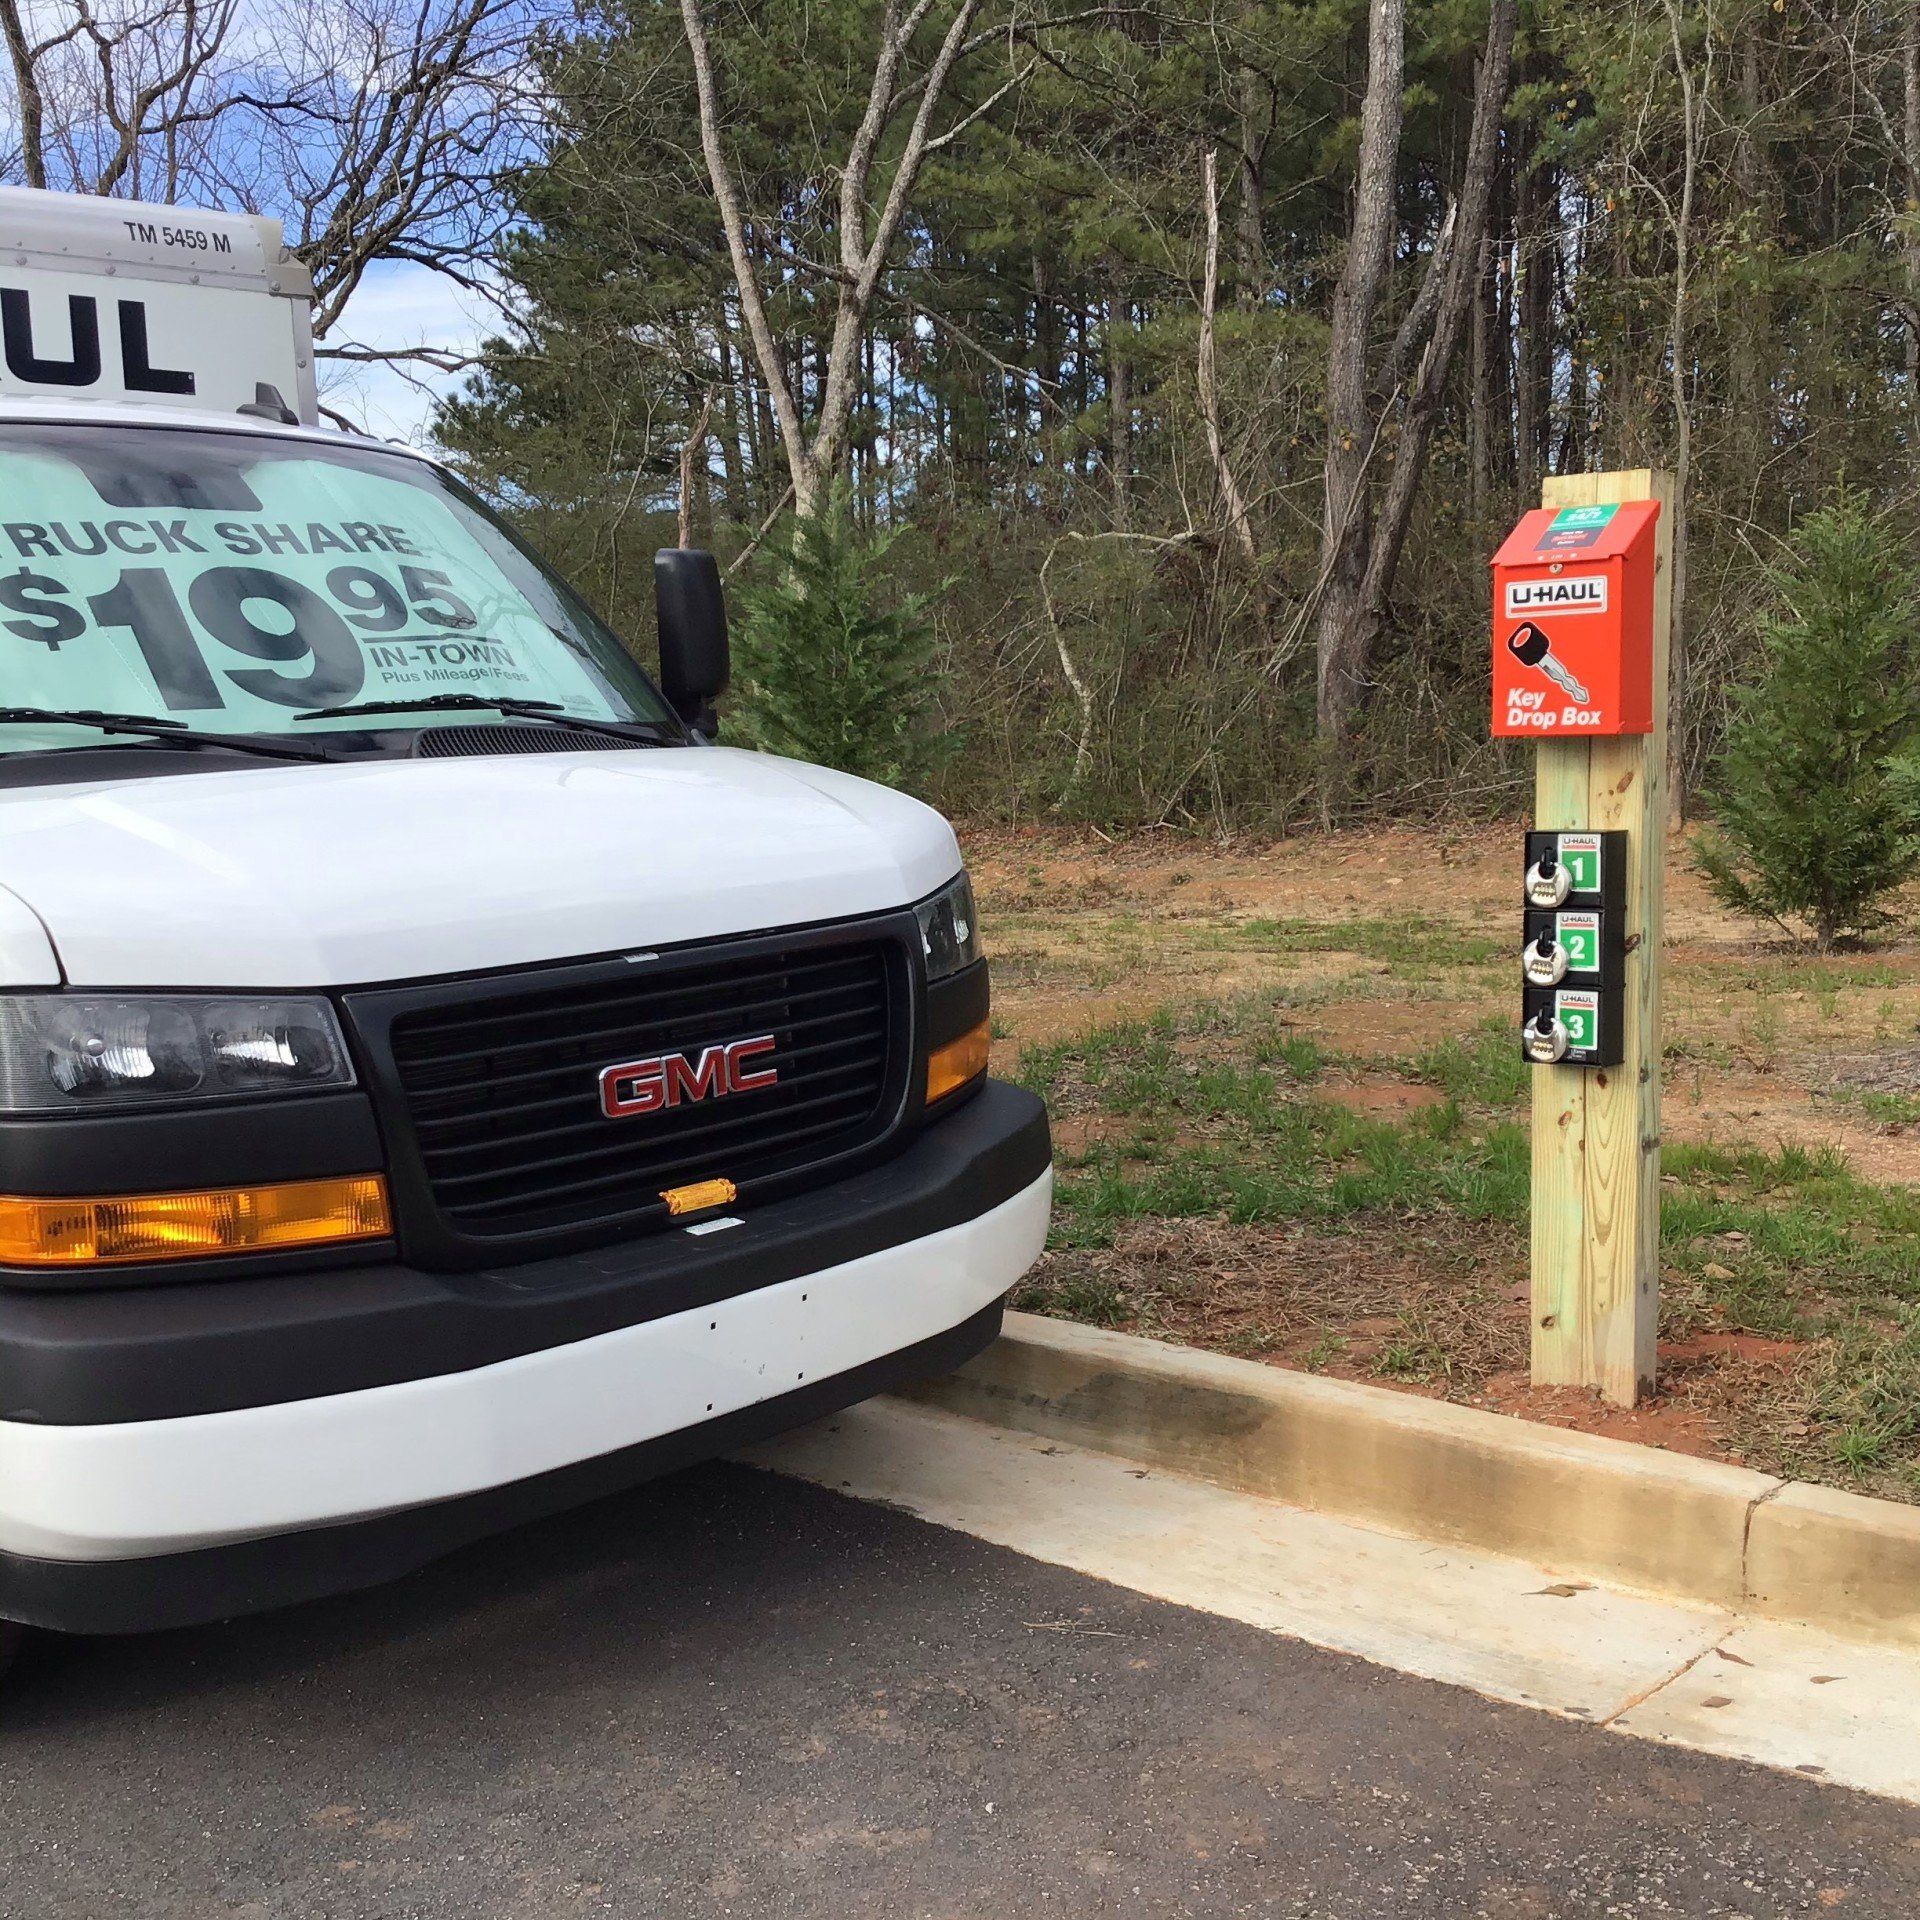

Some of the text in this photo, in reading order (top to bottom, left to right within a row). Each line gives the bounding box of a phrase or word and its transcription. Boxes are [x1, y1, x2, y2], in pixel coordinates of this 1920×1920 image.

[123, 221, 232, 253] TM 5459 M
[0, 287, 196, 396] UL
[0, 520, 424, 557] RUCK SHARE
[369, 643, 516, 668] IN-TOWN
[381, 667, 530, 683] Plus Mileage/Fees
[1507, 688, 1546, 710] Key
[1506, 707, 1602, 730] Drop Box
[1572, 857, 1584, 881] 1
[1570, 935, 1585, 959] 2
[1569, 1015, 1584, 1039] 3
[599, 1034, 778, 1119] GMC
